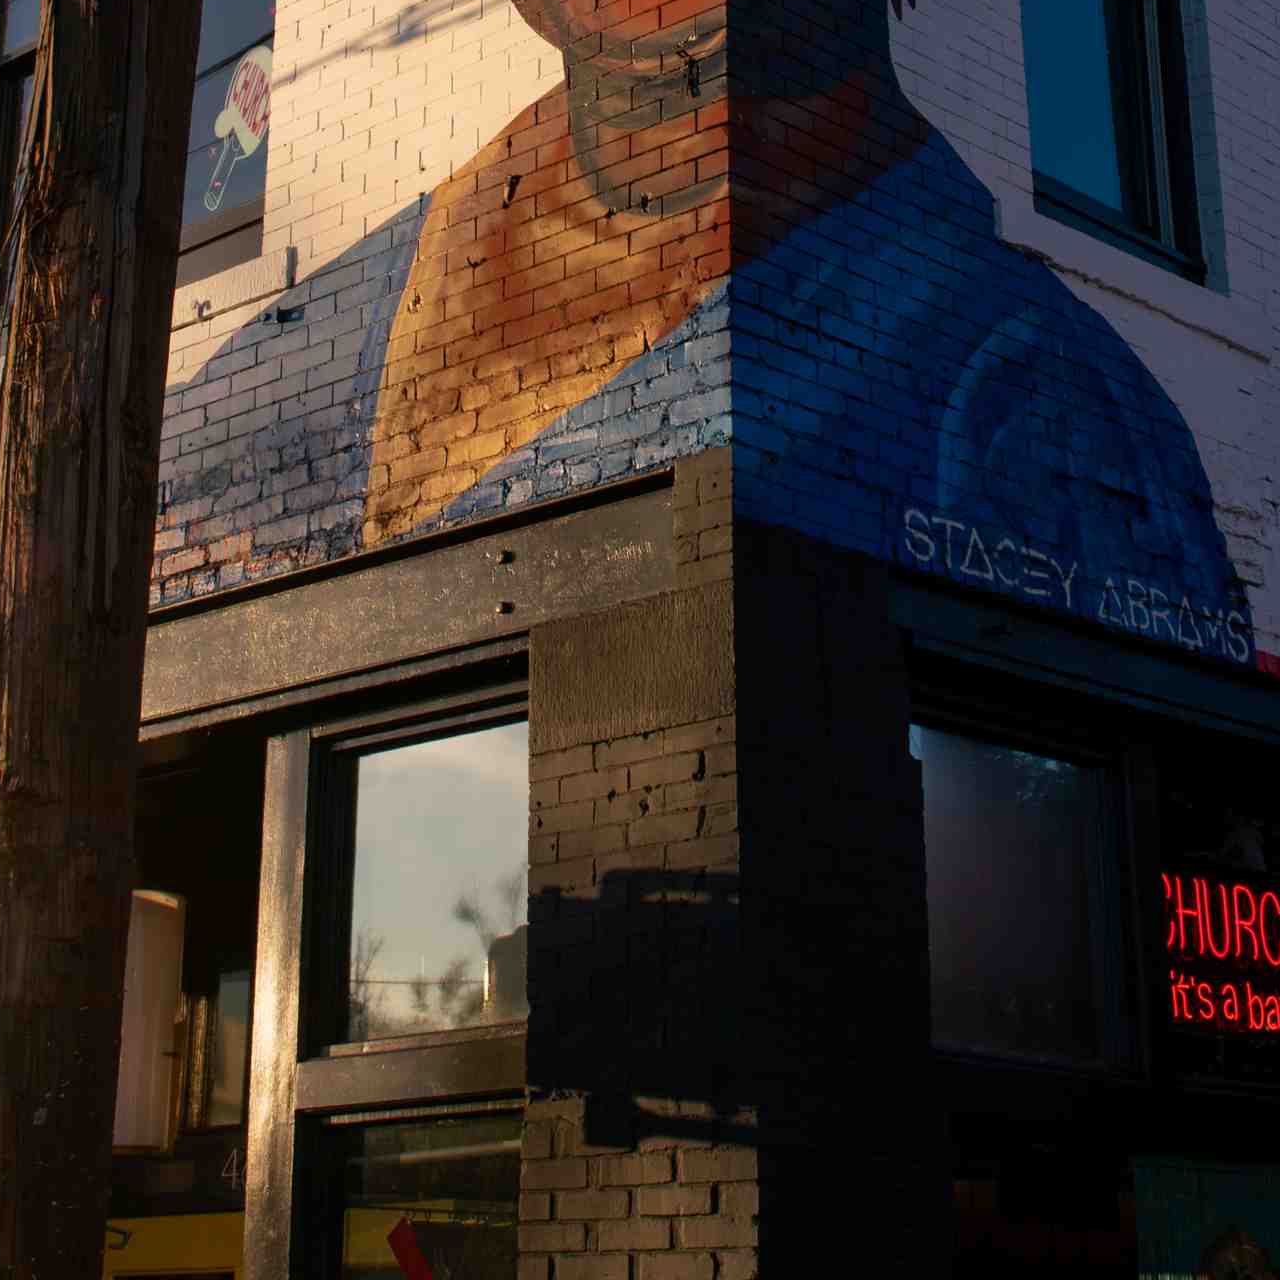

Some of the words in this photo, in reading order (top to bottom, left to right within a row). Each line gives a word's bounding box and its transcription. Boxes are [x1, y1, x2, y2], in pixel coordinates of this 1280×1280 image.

[903, 508, 1078, 609] STACEY
[1098, 577, 1250, 664] ABRAMS
[1169, 969, 1215, 1020] it's
[1222, 983, 1238, 1020] a
